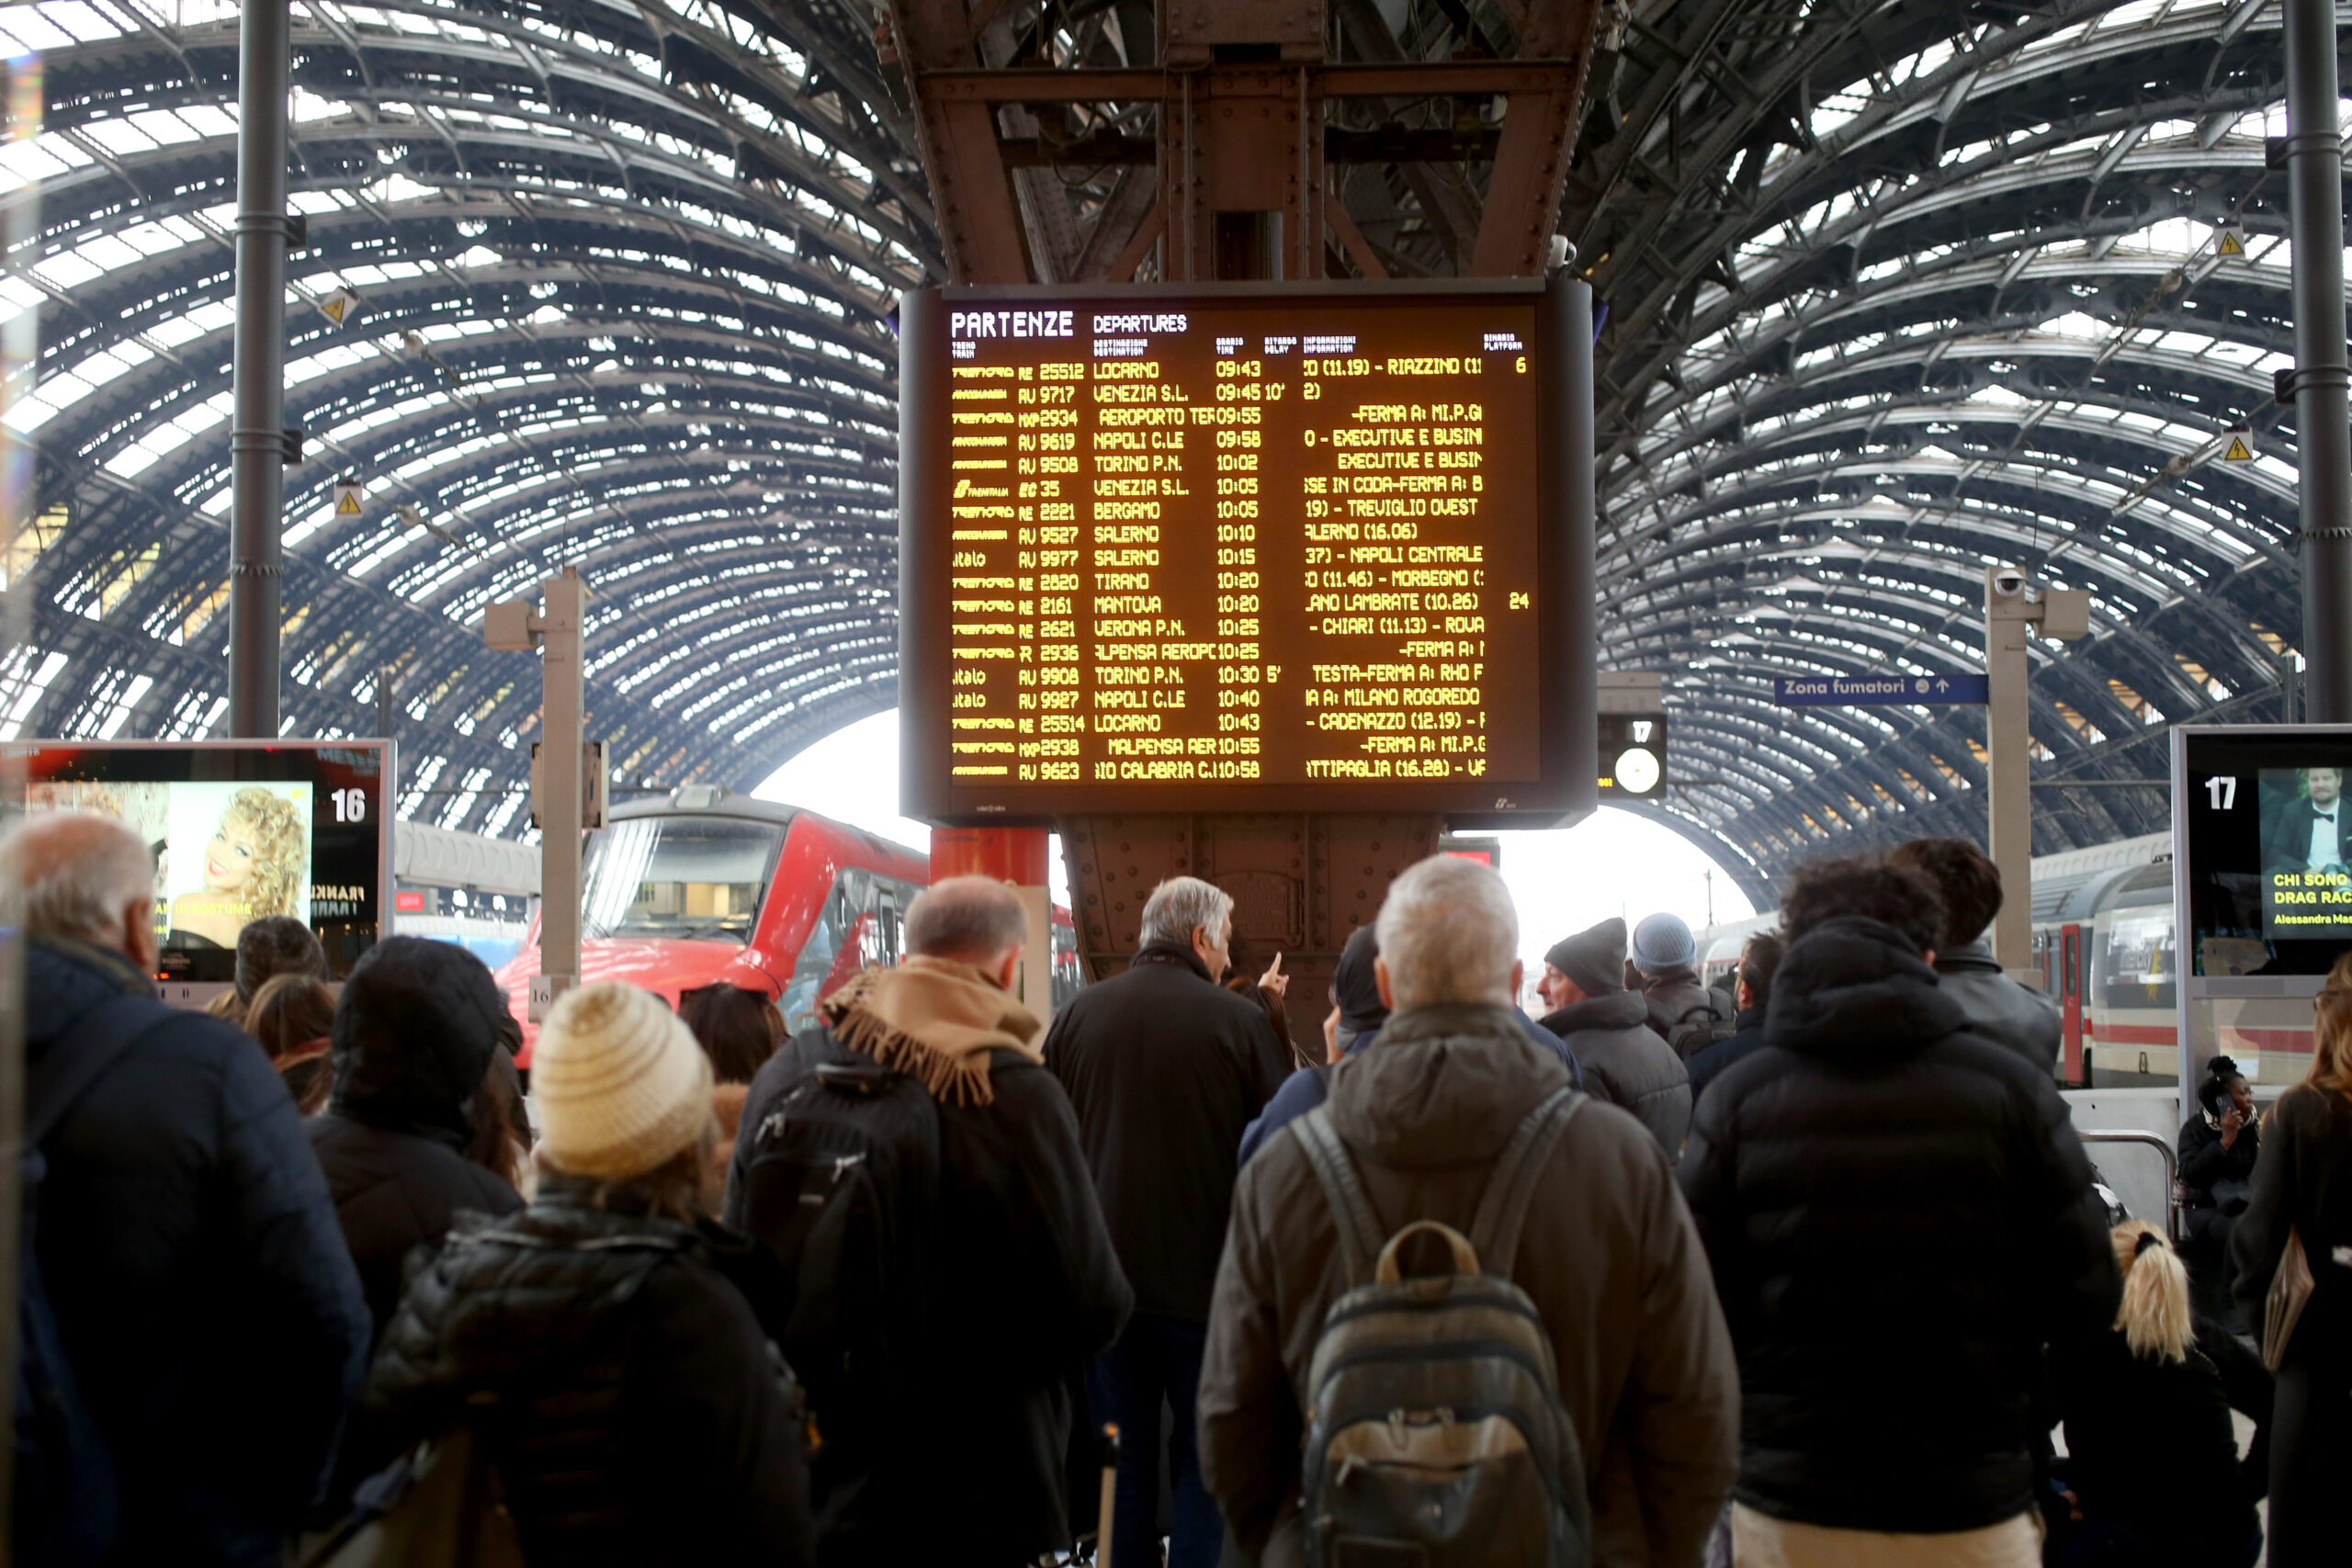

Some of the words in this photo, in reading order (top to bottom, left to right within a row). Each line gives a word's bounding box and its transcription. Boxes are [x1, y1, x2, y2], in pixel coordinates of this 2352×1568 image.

[952, 311, 1073, 338] PARTENZE
[1093, 315, 1187, 333] DEPARTURES
[1484, 333, 1515, 342] BINARIO
[1265, 345, 1288, 355] DELAY
[1484, 342, 1522, 350] PLATFORM
[1019, 367, 1033, 380] RE
[1040, 363, 1084, 380] 25512
[1093, 362, 1159, 379] LOCARNO
[1217, 361, 1261, 378] 09:43
[1323, 359, 1369, 376] (11.19)
[1388, 358, 1459, 375] RIAZZINO
[1516, 357, 1526, 373] 6
[1019, 389, 1035, 404] AV
[1040, 386, 1075, 403] 9717
[1093, 385, 1156, 402] VENEZIA
[1161, 384, 1188, 401] S.L.
[1217, 383, 1261, 400] 09:45
[1040, 410, 1078, 427] 2934
[1099, 408, 1184, 426] AEROPORTO
[1217, 407, 1261, 424] 09:55
[1351, 405, 1407, 423] -FERMA
[1411, 404, 1426, 422] A:
[1019, 434, 1036, 451] AV
[1040, 433, 1075, 450] 9619
[1094, 432, 1146, 449] NAPOLI
[1152, 432, 1183, 448] C.LE
[1217, 431, 1261, 448] 09:58
[1333, 429, 1415, 446] EXECUTIVE
[1419, 429, 1429, 446] E
[1019, 457, 1035, 475] AV
[1040, 457, 1079, 473] 9508
[1094, 456, 1148, 472] TORINO
[1153, 456, 1182, 471] P.N.
[1217, 455, 1258, 470] 10:02
[1338, 452, 1419, 469] EXECUTIVE
[1424, 452, 1434, 468] E
[1019, 482, 1037, 498] EC
[1040, 480, 1059, 497] 35
[1094, 479, 1157, 496] VENEZIA
[1161, 479, 1189, 495] S.L.
[1217, 478, 1258, 494] 10:05
[1333, 477, 1349, 493] IN
[1353, 476, 1447, 493] CODA-FERMA
[1452, 476, 1466, 491] A:
[1019, 506, 1033, 521] RE
[1040, 503, 1075, 521] 2221
[1094, 502, 1160, 520] BERGAMO
[1217, 501, 1258, 518] 10:05
[1347, 499, 1426, 516] TREVIGLIO
[1430, 498, 1478, 515] OVEST
[1019, 528, 1036, 545] AV
[1040, 526, 1079, 544] 9527
[1094, 525, 1159, 543] SALERNO
[1217, 525, 1255, 542] 10:10
[1364, 523, 1417, 540] (16.06)
[1019, 551, 1036, 569] AV
[1040, 550, 1079, 567] 9977
[1094, 549, 1159, 566] SALERNO
[1217, 548, 1255, 565] 10:15
[1351, 547, 1403, 563] NAPOLI
[1408, 546, 1483, 563] CENTRALE
[1019, 578, 1034, 591] RE
[1040, 574, 1079, 591] 2820
[1095, 573, 1149, 590] TIRANO
[1217, 572, 1259, 589] 10:20
[1323, 570, 1373, 587] (11.46)
[1392, 570, 1468, 587] MORBEGNO
[1019, 600, 1034, 615] RE
[1040, 597, 1072, 615] 2161
[1094, 596, 1161, 614] MANTOVA
[1217, 595, 1259, 613] 10:20
[1344, 593, 1419, 611] LAMBRATE
[1425, 592, 1478, 610] (10.26)
[1510, 592, 1529, 609] 24
[1019, 624, 1034, 638] RE
[1040, 620, 1075, 637] 2621
[1094, 620, 1151, 637] VERONA
[1156, 619, 1185, 636] P.N.
[1218, 619, 1259, 636] 10:25
[1323, 617, 1374, 635] CHIARI
[1380, 617, 1427, 634] (11.13)
[1019, 646, 1032, 662] R
[1041, 645, 1079, 661] 2936
[1218, 643, 1259, 660] 10:25
[1399, 641, 1453, 657] -FERMA
[1459, 641, 1474, 657] A:
[1019, 670, 1036, 686] AV
[1041, 667, 1079, 685] 9908
[1095, 667, 1149, 684] TORINO
[1154, 666, 1183, 683] P.N.
[1218, 666, 1260, 683] 10:30
[1313, 664, 1415, 682] TESTA-FERMA
[1419, 664, 1434, 682] A:
[1441, 664, 1469, 681] RHO
[1785, 680, 1827, 694] Zona
[1833, 678, 1905, 694] fumatori
[1019, 694, 1036, 709] AV
[1041, 691, 1079, 709] 9927
[1095, 691, 1148, 708] NAPOLI
[1153, 690, 1185, 708] C.LE
[1218, 690, 1260, 707] 10:40
[1323, 689, 1339, 705] A:
[1344, 688, 1398, 705] MILANO
[1403, 687, 1479, 705] ROGOREDO
[1019, 718, 1034, 733] RE
[1041, 715, 1085, 732] 25514
[1095, 715, 1160, 732] LOCARNO
[1218, 714, 1260, 731] 10:43
[1319, 712, 1406, 730] CADENAZZO
[1411, 712, 1461, 729] (12.19)
[1633, 721, 1653, 742] 17
[1040, 739, 1080, 756] 2938
[1108, 739, 1183, 755] MALPENSA
[1218, 738, 1260, 754] 10:55
[1361, 737, 1416, 753] -FERMA
[1420, 736, 1435, 752] A:
[1019, 764, 1036, 781] AV
[1041, 761, 1080, 780] 9623
[1121, 761, 1193, 779] CALABRIA
[1219, 761, 1260, 778] 10:58
[1396, 759, 1450, 777] (16.28)
[2205, 775, 2236, 810] 17
[331, 788, 365, 822] 16
[2273, 874, 2301, 886] CHI
[2304, 874, 2348, 886] SONO
[2274, 891, 2317, 904] DRAG
[2322, 891, 2352, 904] RAC
[190, 903, 253, 915] COSTUME
[2274, 914, 2332, 924] Alessandra
[534, 988, 549, 1003] 16
